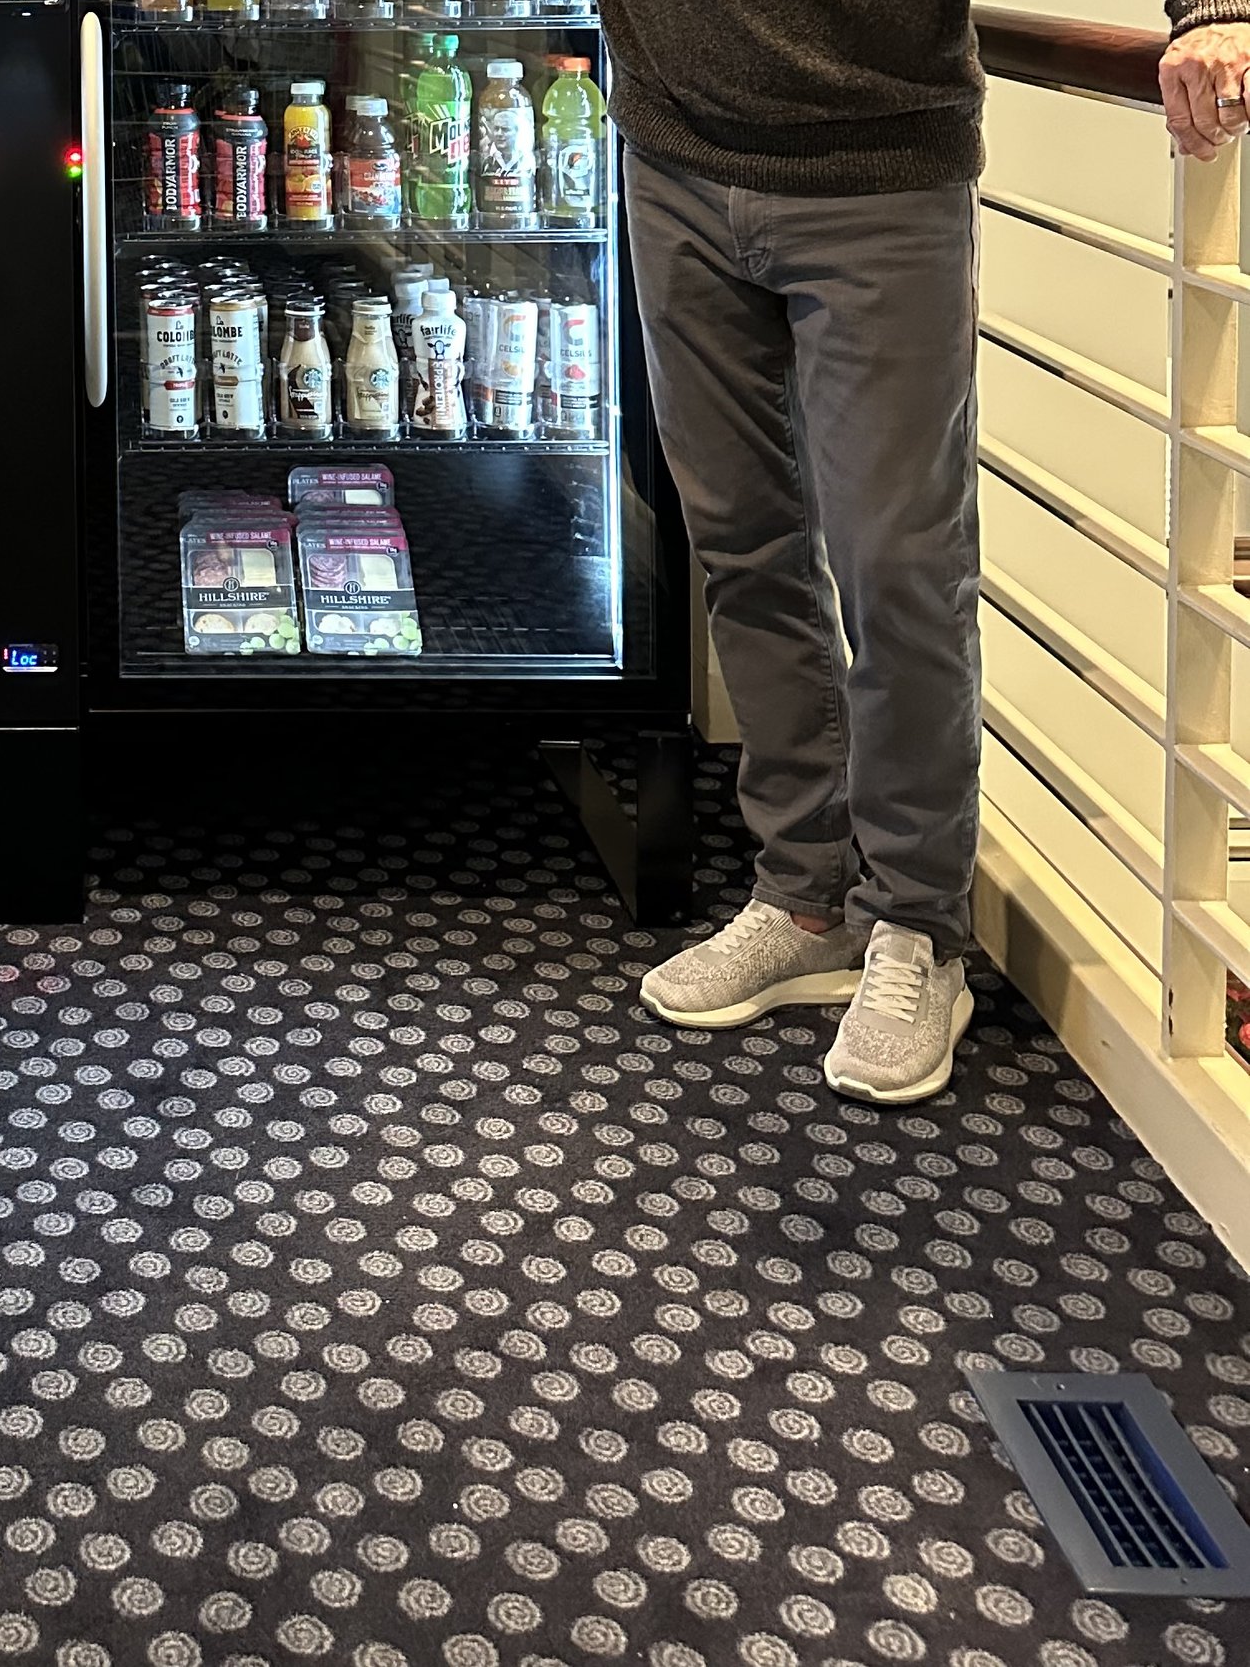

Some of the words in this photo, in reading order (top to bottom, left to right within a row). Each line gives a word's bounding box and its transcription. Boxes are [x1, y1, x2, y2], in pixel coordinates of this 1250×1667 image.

[236, 145, 247, 221] BODYARMOR
[212, 326, 242, 338] LOMBE
[420, 325, 456, 336] fairlife
[498, 344, 525, 353] CELSIU
[222, 350, 243, 366] LATTE
[199, 592, 267, 602] HILLSHIRE
[320, 595, 387, 605] HILLSHIRE
